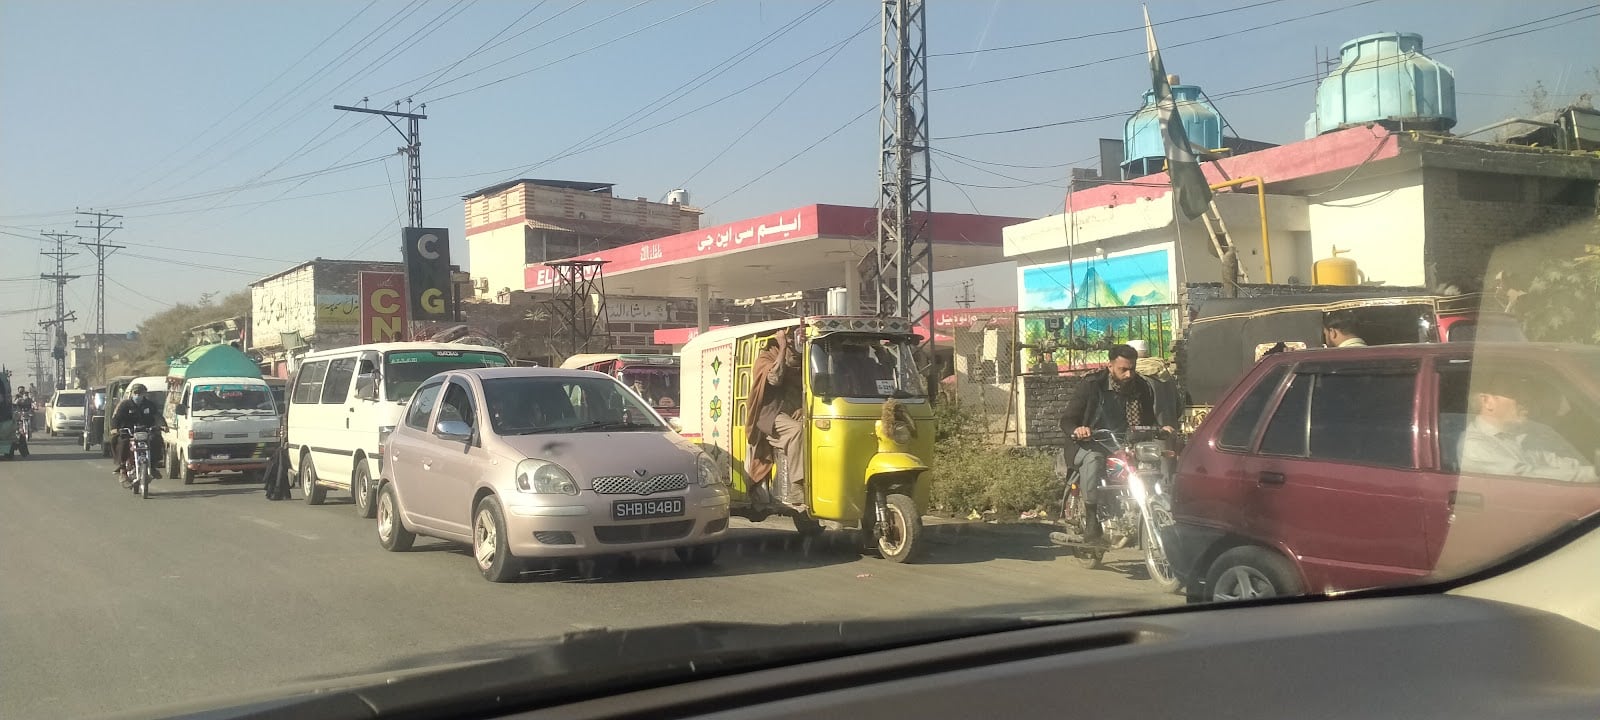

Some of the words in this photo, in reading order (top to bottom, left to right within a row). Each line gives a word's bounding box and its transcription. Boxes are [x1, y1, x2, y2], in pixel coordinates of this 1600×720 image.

[697, 233, 714, 251] جی
[716, 225, 732, 247] این
[735, 226, 754, 244] سی
[616, 500, 681, 517] SHB1948D
